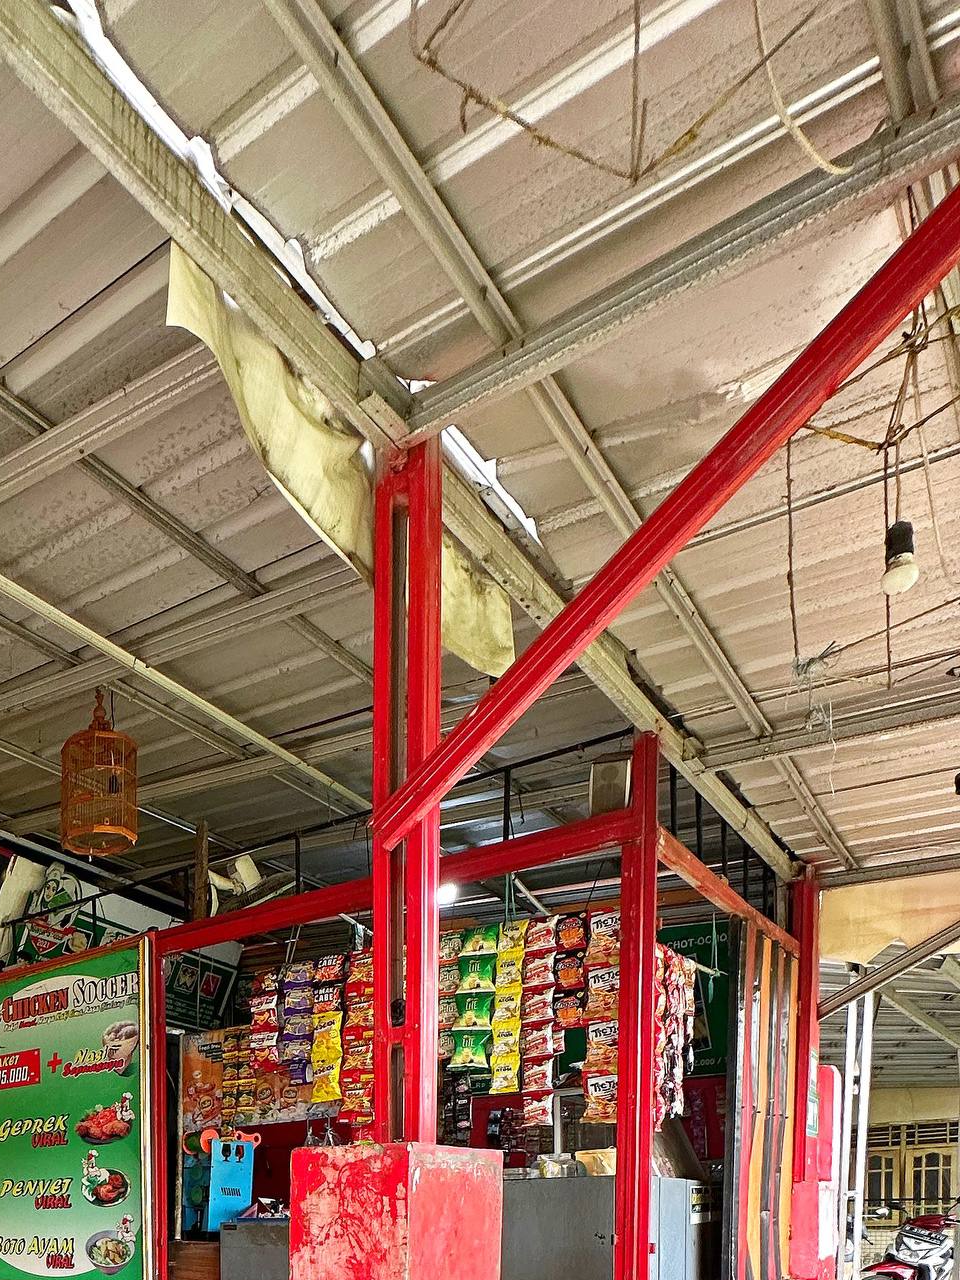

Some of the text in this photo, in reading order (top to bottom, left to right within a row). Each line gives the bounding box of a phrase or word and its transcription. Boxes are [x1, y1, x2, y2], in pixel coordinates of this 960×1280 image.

[1, 970, 139, 1023] CHICKEN SOCCER
[314, 993, 334, 1003] CABE
[0, 1114, 71, 1142] GEPREK
[31, 1131, 69, 1148] VIRAL
[0, 1178, 74, 1198] PENYET
[35, 1194, 72, 1210] VIRAL
[26, 1236, 75, 1259] AYAM
[46, 1253, 75, 1269] VIRAL
